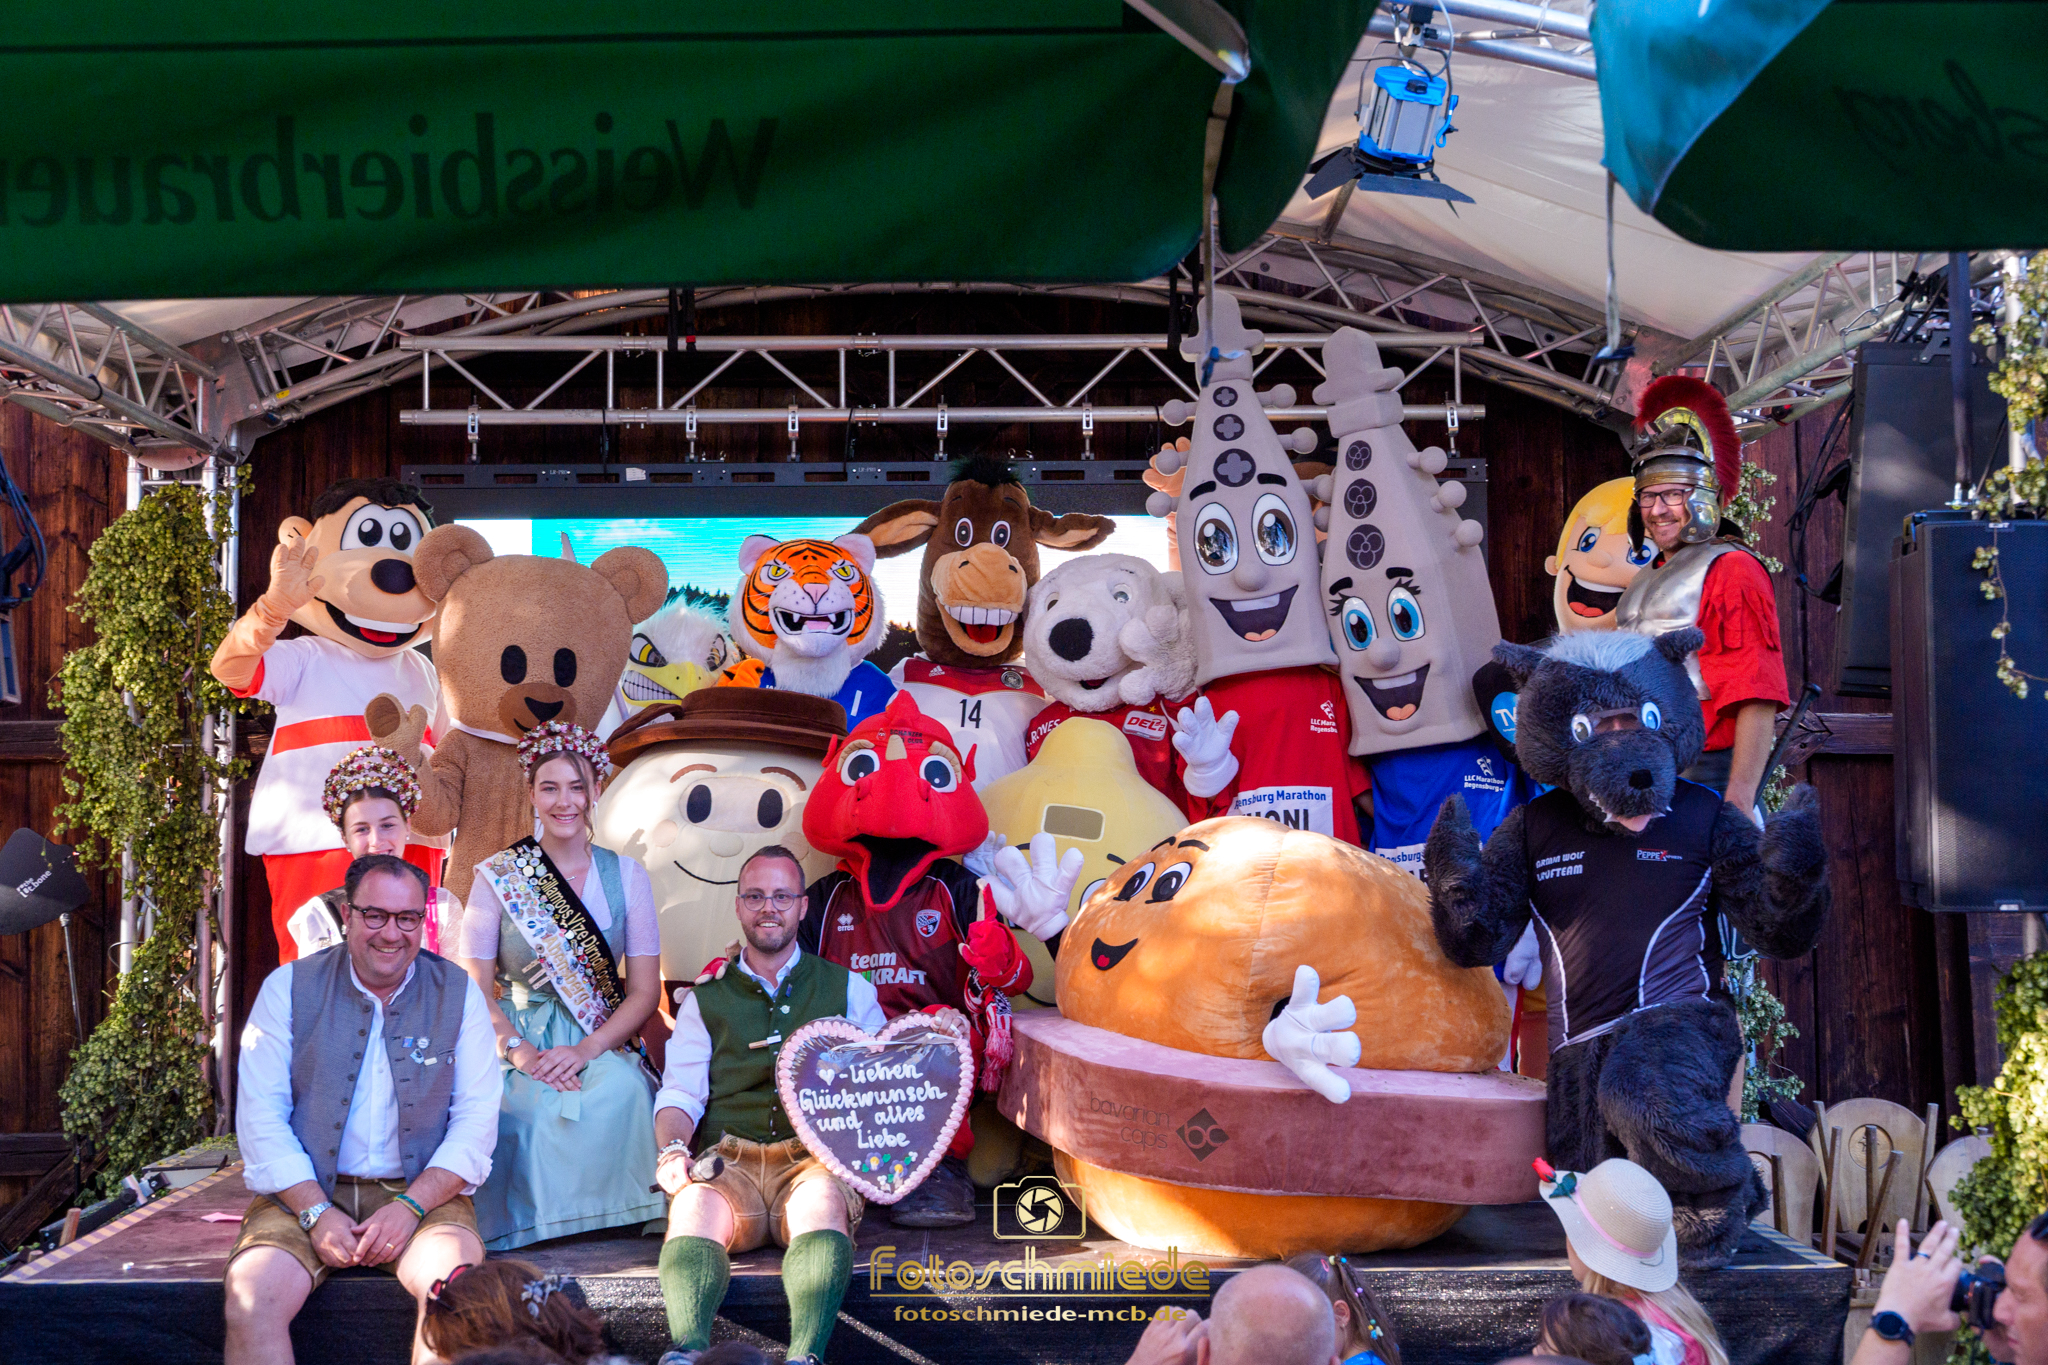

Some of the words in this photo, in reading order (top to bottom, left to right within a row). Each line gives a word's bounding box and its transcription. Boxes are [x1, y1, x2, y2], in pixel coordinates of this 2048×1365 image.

[959, 698, 982, 729] 14
[1475, 775, 1505, 785] Marathon
[1276, 789, 1327, 801] Marathon
[1562, 851, 1586, 862] WOLF
[537, 872, 575, 919] Gillamoos
[567, 912, 589, 941] Vize
[580, 934, 616, 999] Dirndlkönigin
[541, 935, 590, 1006] Abensberg
[850, 952, 897, 970] team
[816, 1110, 863, 1132] und
[875, 1105, 925, 1125] alles
[1090, 1090, 1170, 1128] bavarian
[857, 1127, 910, 1149] Liebe
[1120, 1126, 1168, 1152] caps
